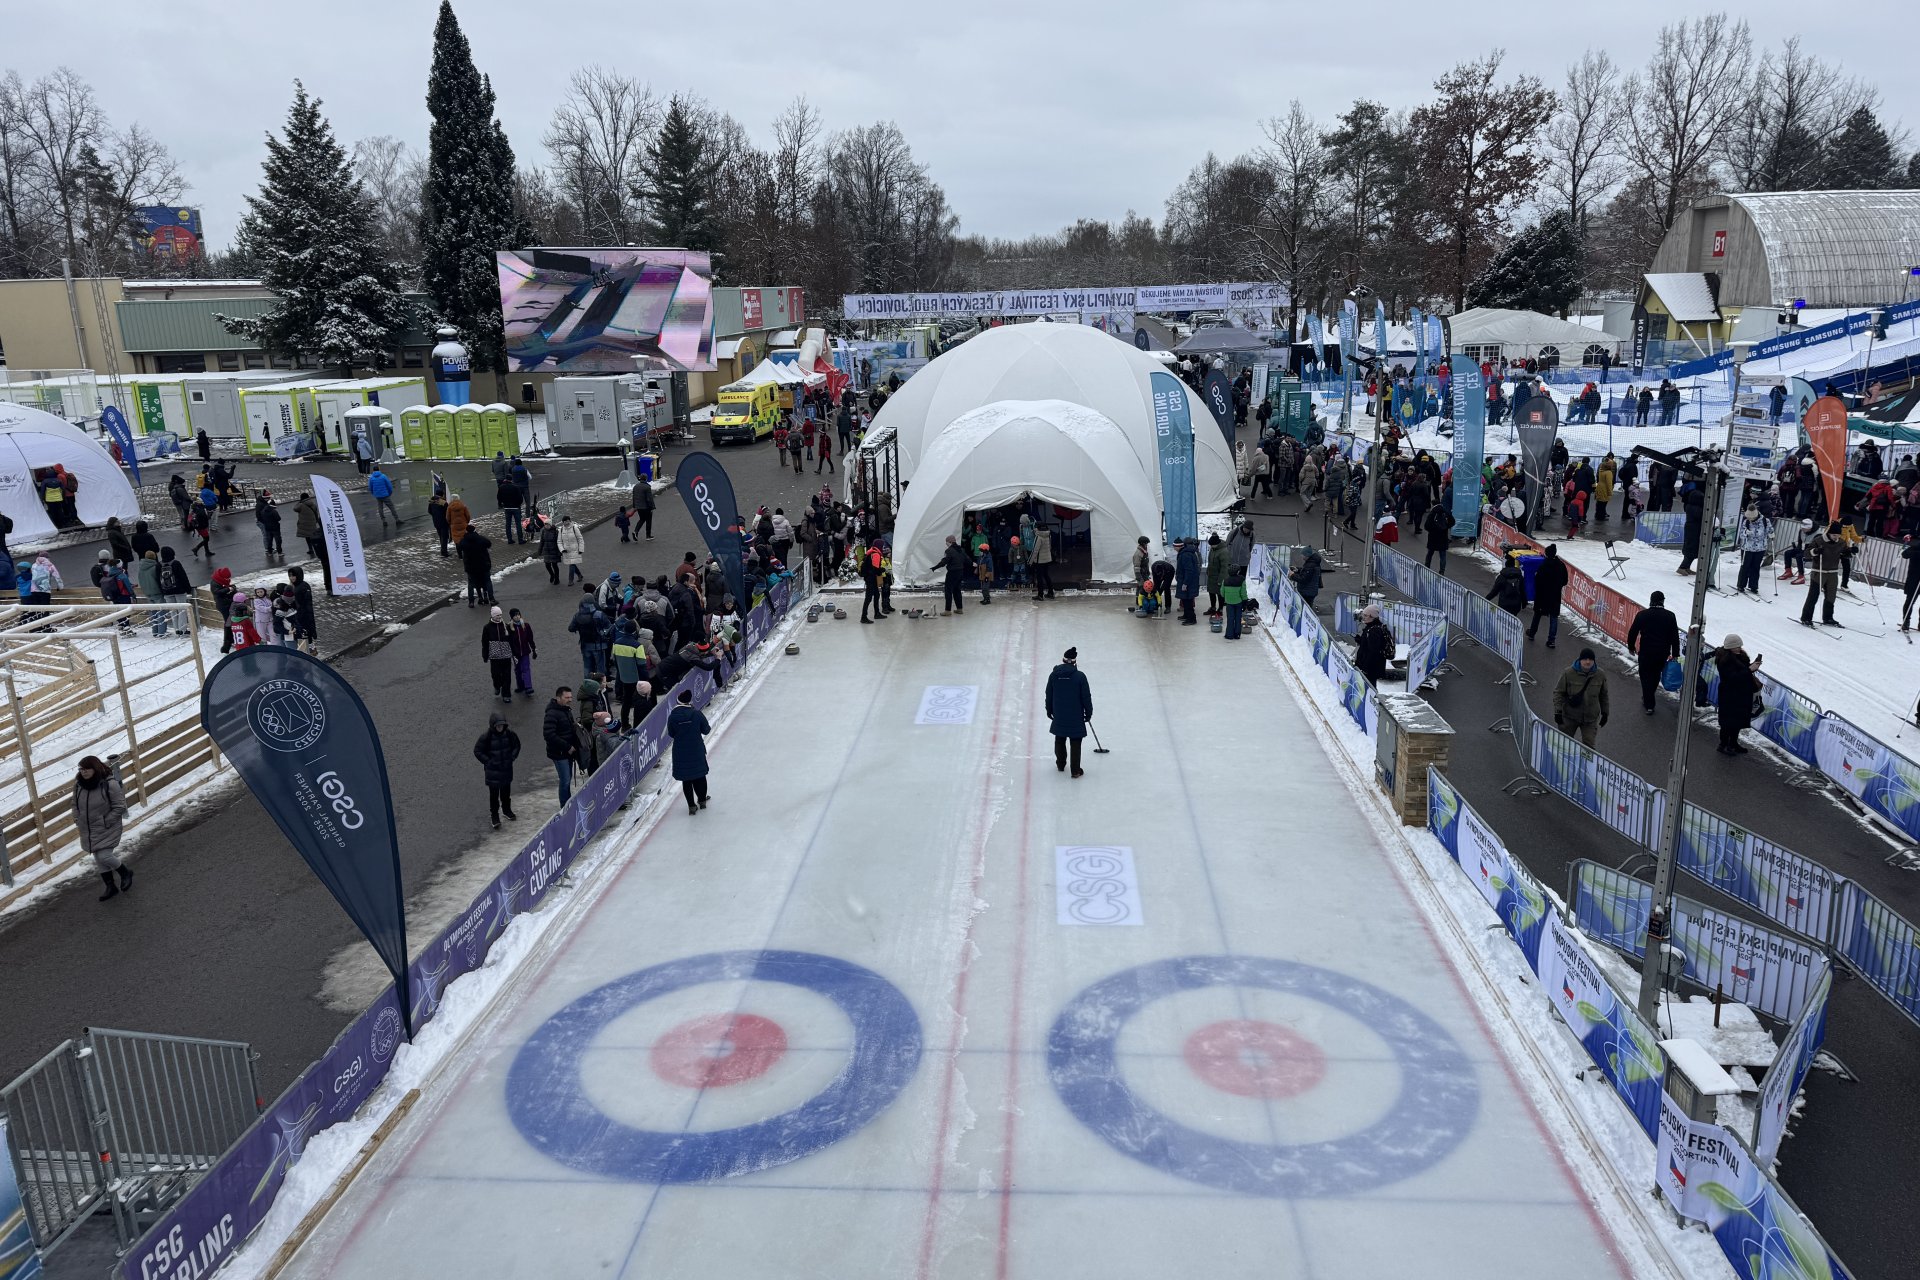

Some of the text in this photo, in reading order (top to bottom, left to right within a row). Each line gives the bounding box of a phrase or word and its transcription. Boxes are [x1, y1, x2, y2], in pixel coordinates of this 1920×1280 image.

[1713, 234, 1725, 254] B1
[1141, 286, 1224, 298] DĚKUJEME VÁM ZA NÁVŠTĚVU
[1849, 318, 1872, 331] SAMS
[1892, 304, 1920, 320] SAMSU
[1762, 338, 1800, 355] SAMSUNG
[1805, 327, 1844, 344] SAMSUNG
[1718, 349, 1757, 367] SAMNG
[142, 398, 150, 413] ŠATNA
[1212, 383, 1226, 415] CSG
[694, 482, 720, 530] CSG
[924, 686, 971, 722] CSG
[1828, 723, 1875, 760] OLYMPIJSKÝ FESTIVAL
[1466, 815, 1502, 868] OLYMPIJSKÝ FESTIVAL
[1066, 855, 1130, 924] CSG
[443, 914, 474, 952] OLYMPIJSKÝ
[1552, 922, 1600, 996] YMPIJSKÝ FESTIVAL
[334, 1058, 360, 1094] CSG
[350, 1068, 369, 1090] PARTNER
[1660, 1120, 1719, 1168] MILANO CORTINA
[1662, 1103, 1739, 1178] PIJSKÝ FESTIVAL
[1673, 1145, 1685, 1162] 2026
[141, 1224, 184, 1280] CSG
[170, 1214, 233, 1280] RLING
